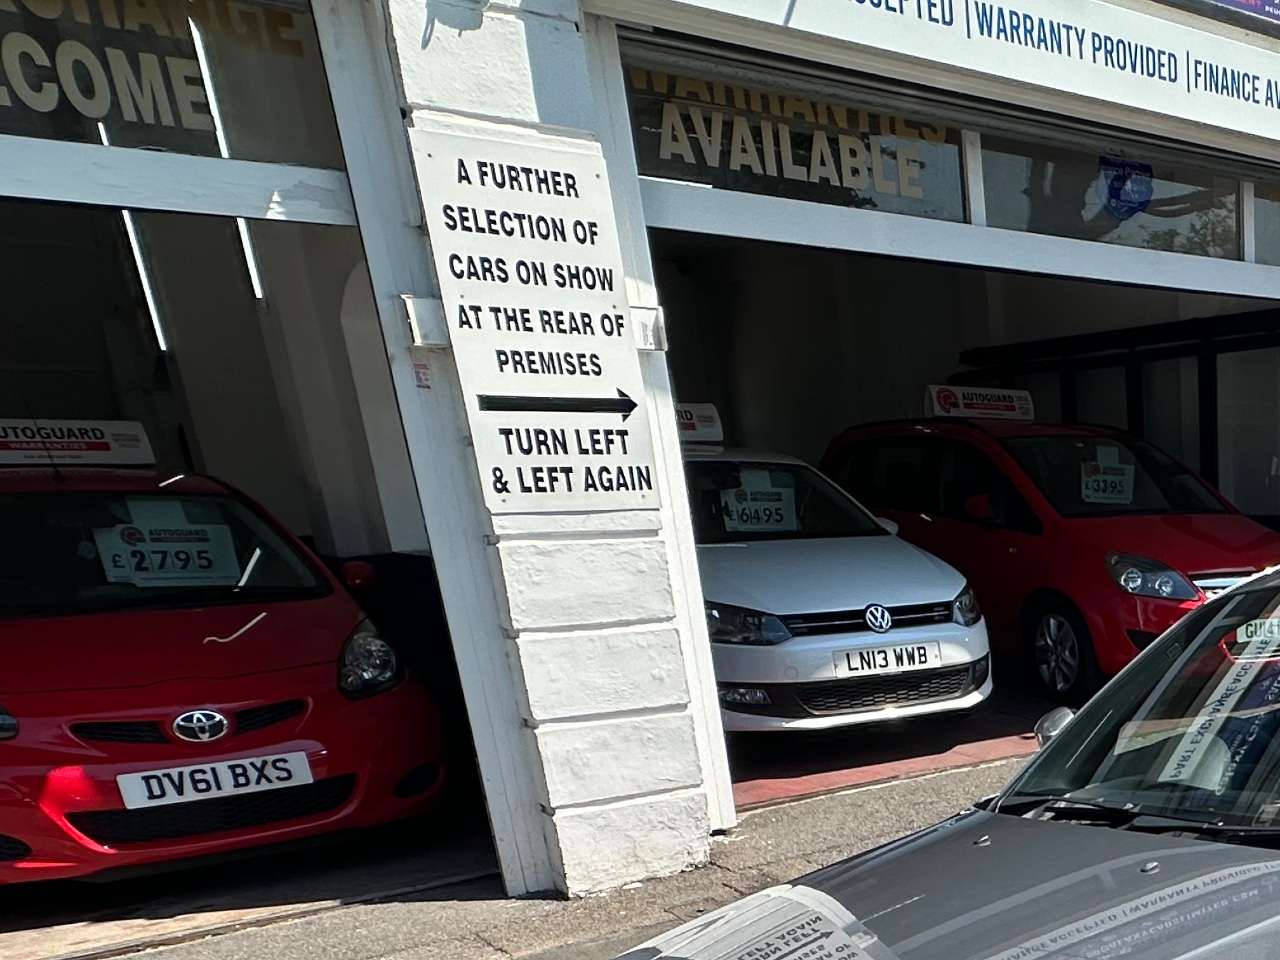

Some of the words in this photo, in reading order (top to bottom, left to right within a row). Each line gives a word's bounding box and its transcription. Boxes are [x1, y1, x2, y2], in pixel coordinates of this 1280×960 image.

[974, 1, 1084, 60] WARRANTY
[1091, 31, 1179, 84] PROVIDED
[0, 31, 213, 130] COME
[1193, 59, 1260, 106] FINANCE
[659, 100, 925, 200] AVAILABLE
[457, 158, 472, 185] A
[476, 161, 580, 198] FURTHER
[442, 204, 567, 243] SELECTION
[572, 219, 598, 245] OF
[449, 253, 509, 283] CARS
[515, 259, 548, 286] ON
[553, 263, 614, 291] SHOW
[458, 304, 482, 329] AT
[488, 306, 534, 332] THE
[538, 309, 596, 336] REAR
[600, 313, 624, 337] OF
[495, 349, 603, 377] PREMISES
[498, 428, 569, 455] TURN
[574, 429, 629, 455] LEFT
[491, 466, 512, 494] &
[516, 466, 573, 493] LEFT
[583, 465, 653, 493] AGAIN
[845, 649, 890, 673] LN13
[893, 644, 929, 669] WWB
[141, 767, 222, 801] DV61
[226, 756, 294, 790] BXS
